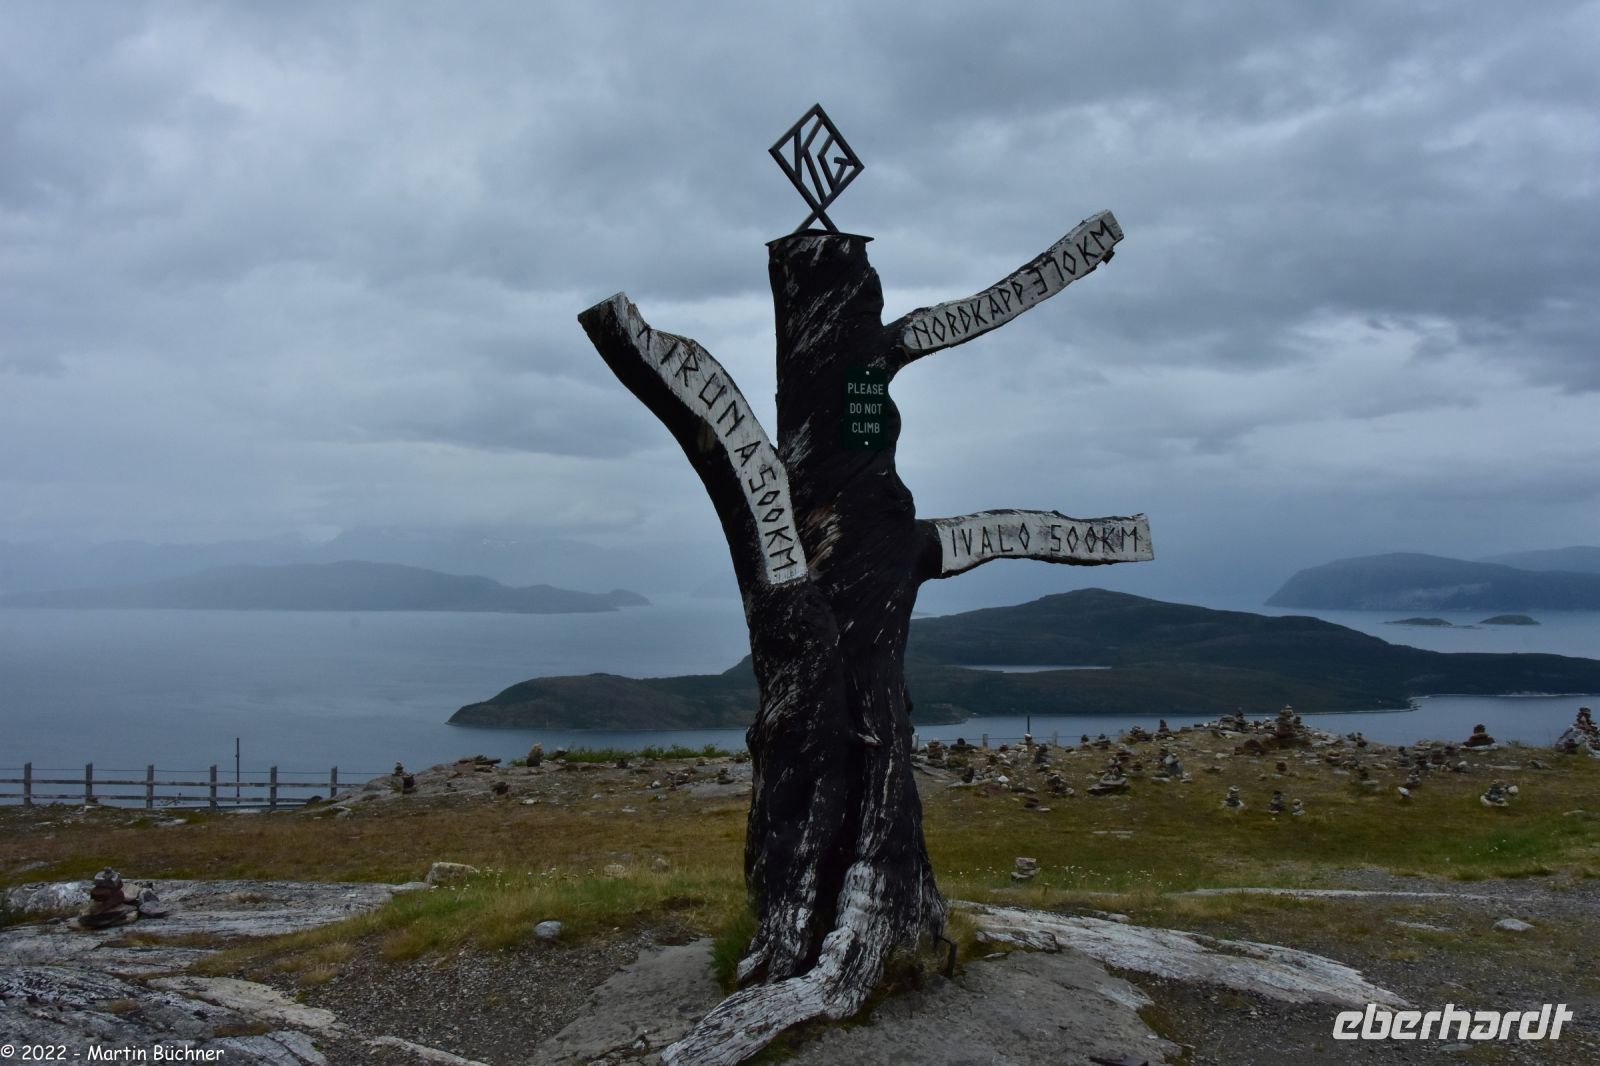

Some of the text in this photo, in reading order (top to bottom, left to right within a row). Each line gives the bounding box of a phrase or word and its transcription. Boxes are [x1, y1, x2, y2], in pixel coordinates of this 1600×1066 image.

[847, 382, 885, 395] PLEASE
[849, 402, 883, 415] DO NOT
[851, 422, 880, 434] CLIMB
